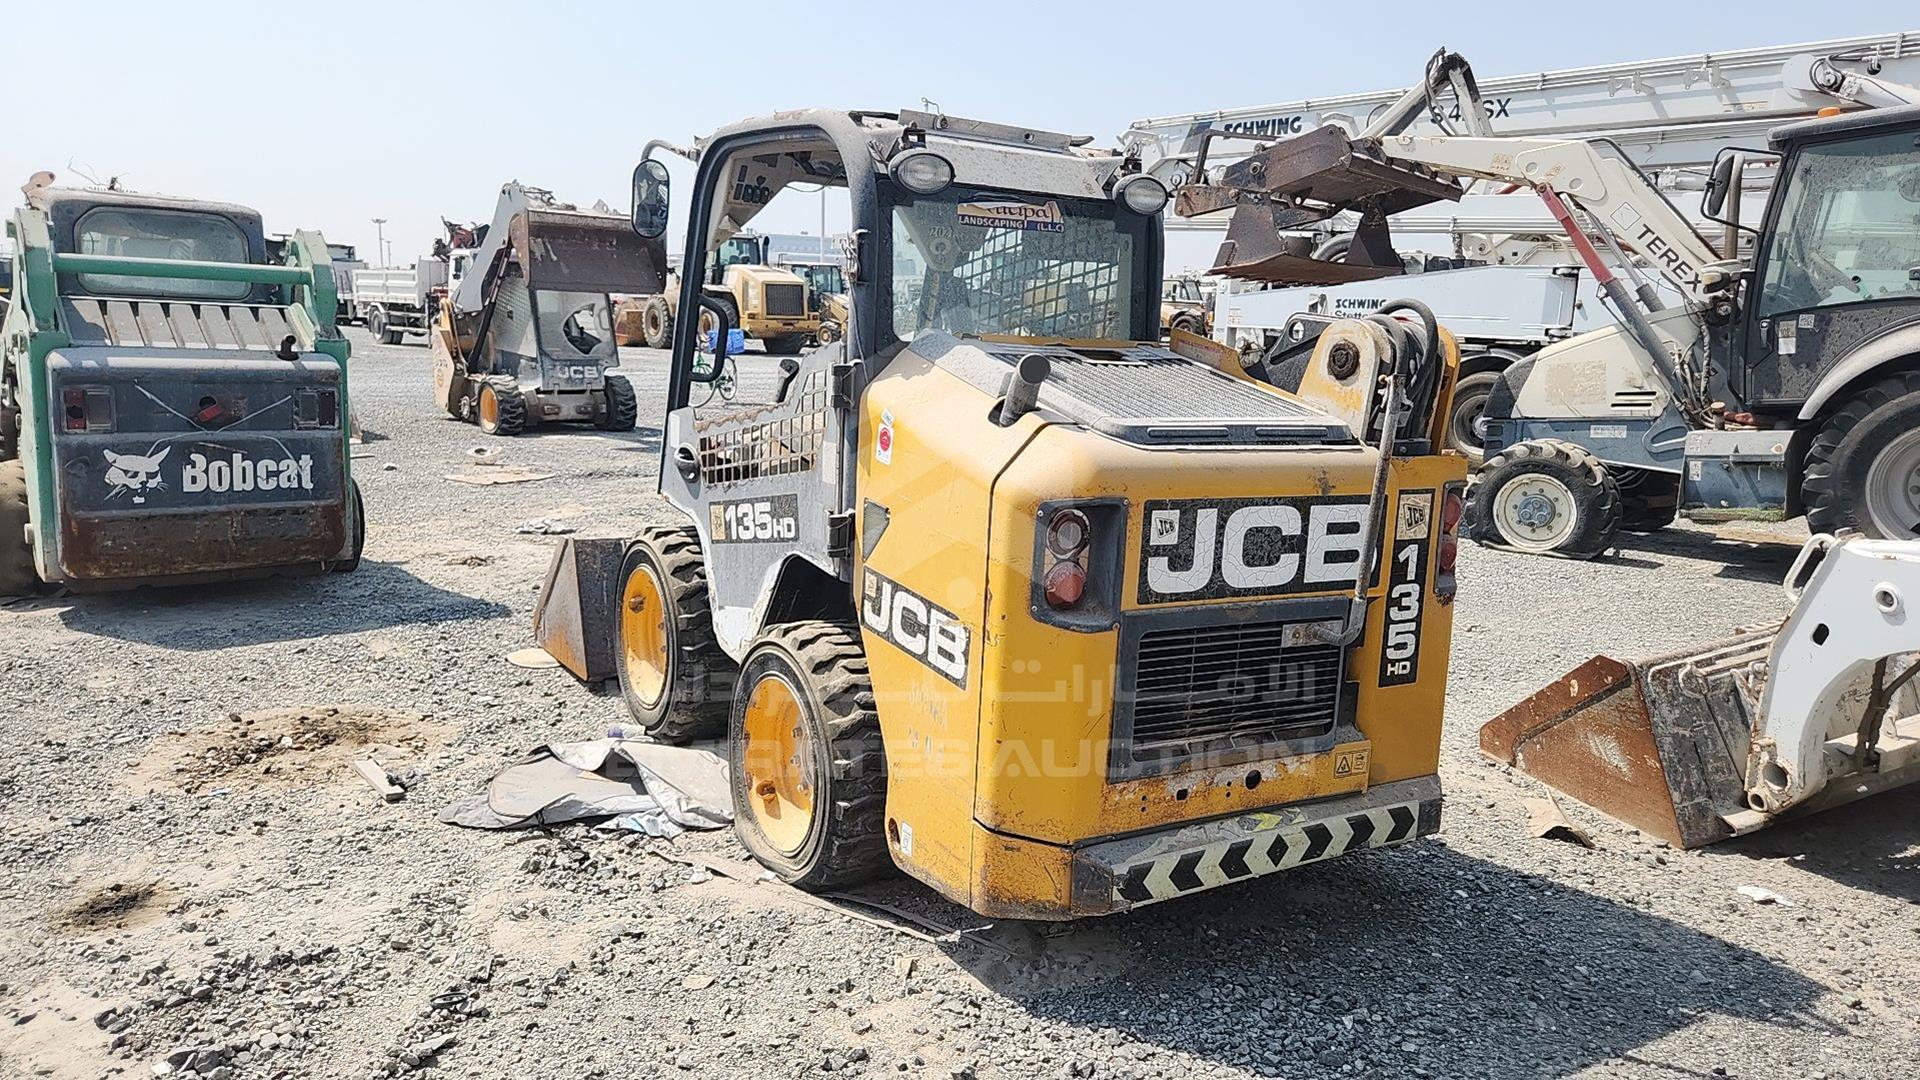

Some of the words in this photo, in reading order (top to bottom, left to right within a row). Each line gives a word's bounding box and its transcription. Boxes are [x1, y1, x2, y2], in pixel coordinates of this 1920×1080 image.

[1224, 116, 1302, 139] SCHWING
[958, 215, 1023, 229] LANDSCAPING
[1637, 223, 1702, 293] TEREX
[557, 366, 599, 378] JCB
[182, 453, 314, 493] Bobcat
[1158, 519, 1175, 536] JCB
[1406, 506, 1424, 528] JCB
[1147, 504, 1377, 594] JCB
[864, 581, 968, 683] JCB
